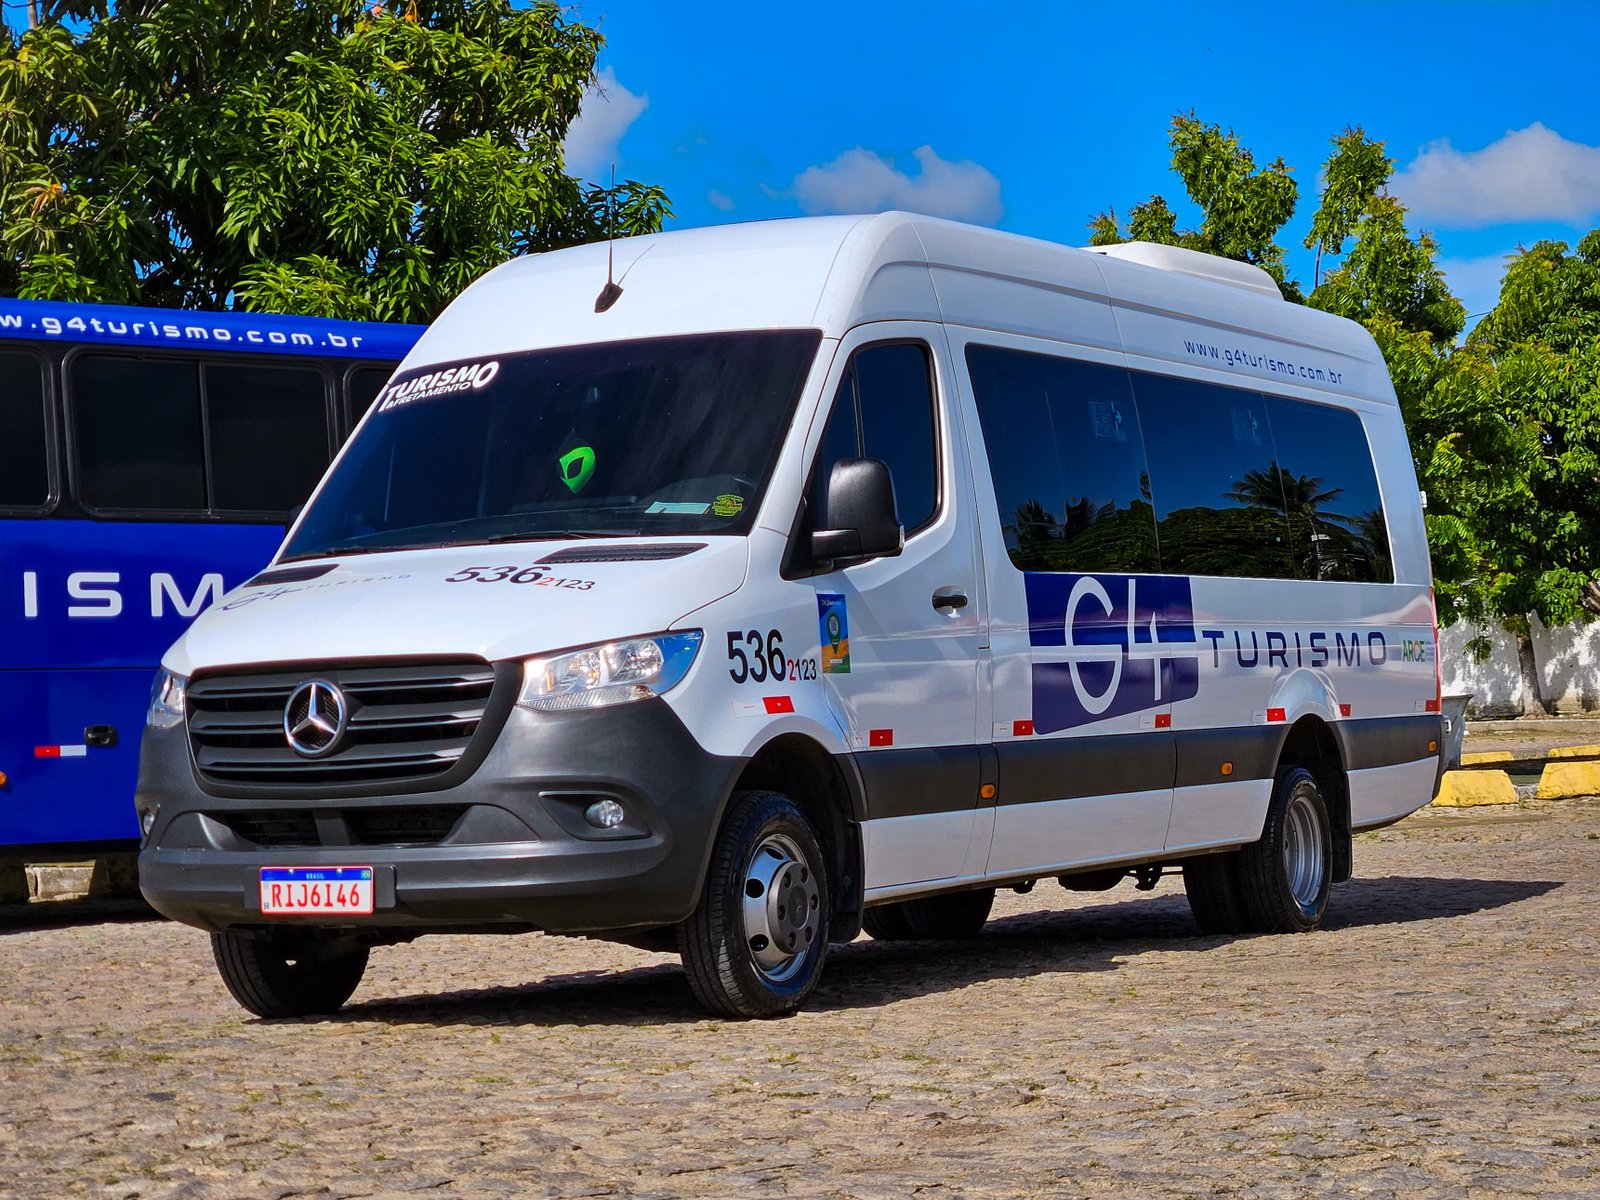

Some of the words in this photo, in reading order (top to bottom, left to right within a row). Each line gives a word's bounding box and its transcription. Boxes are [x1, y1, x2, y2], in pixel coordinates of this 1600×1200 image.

[1183, 340, 1343, 385] www.g4turismo.com.br
[378, 361, 500, 412] TURISMO
[1202, 630, 1388, 669] TURISMO
[1402, 639, 1425, 663] ARCE
[305, 872, 325, 880] BRASIL
[271, 883, 360, 908] RIJ6I46
